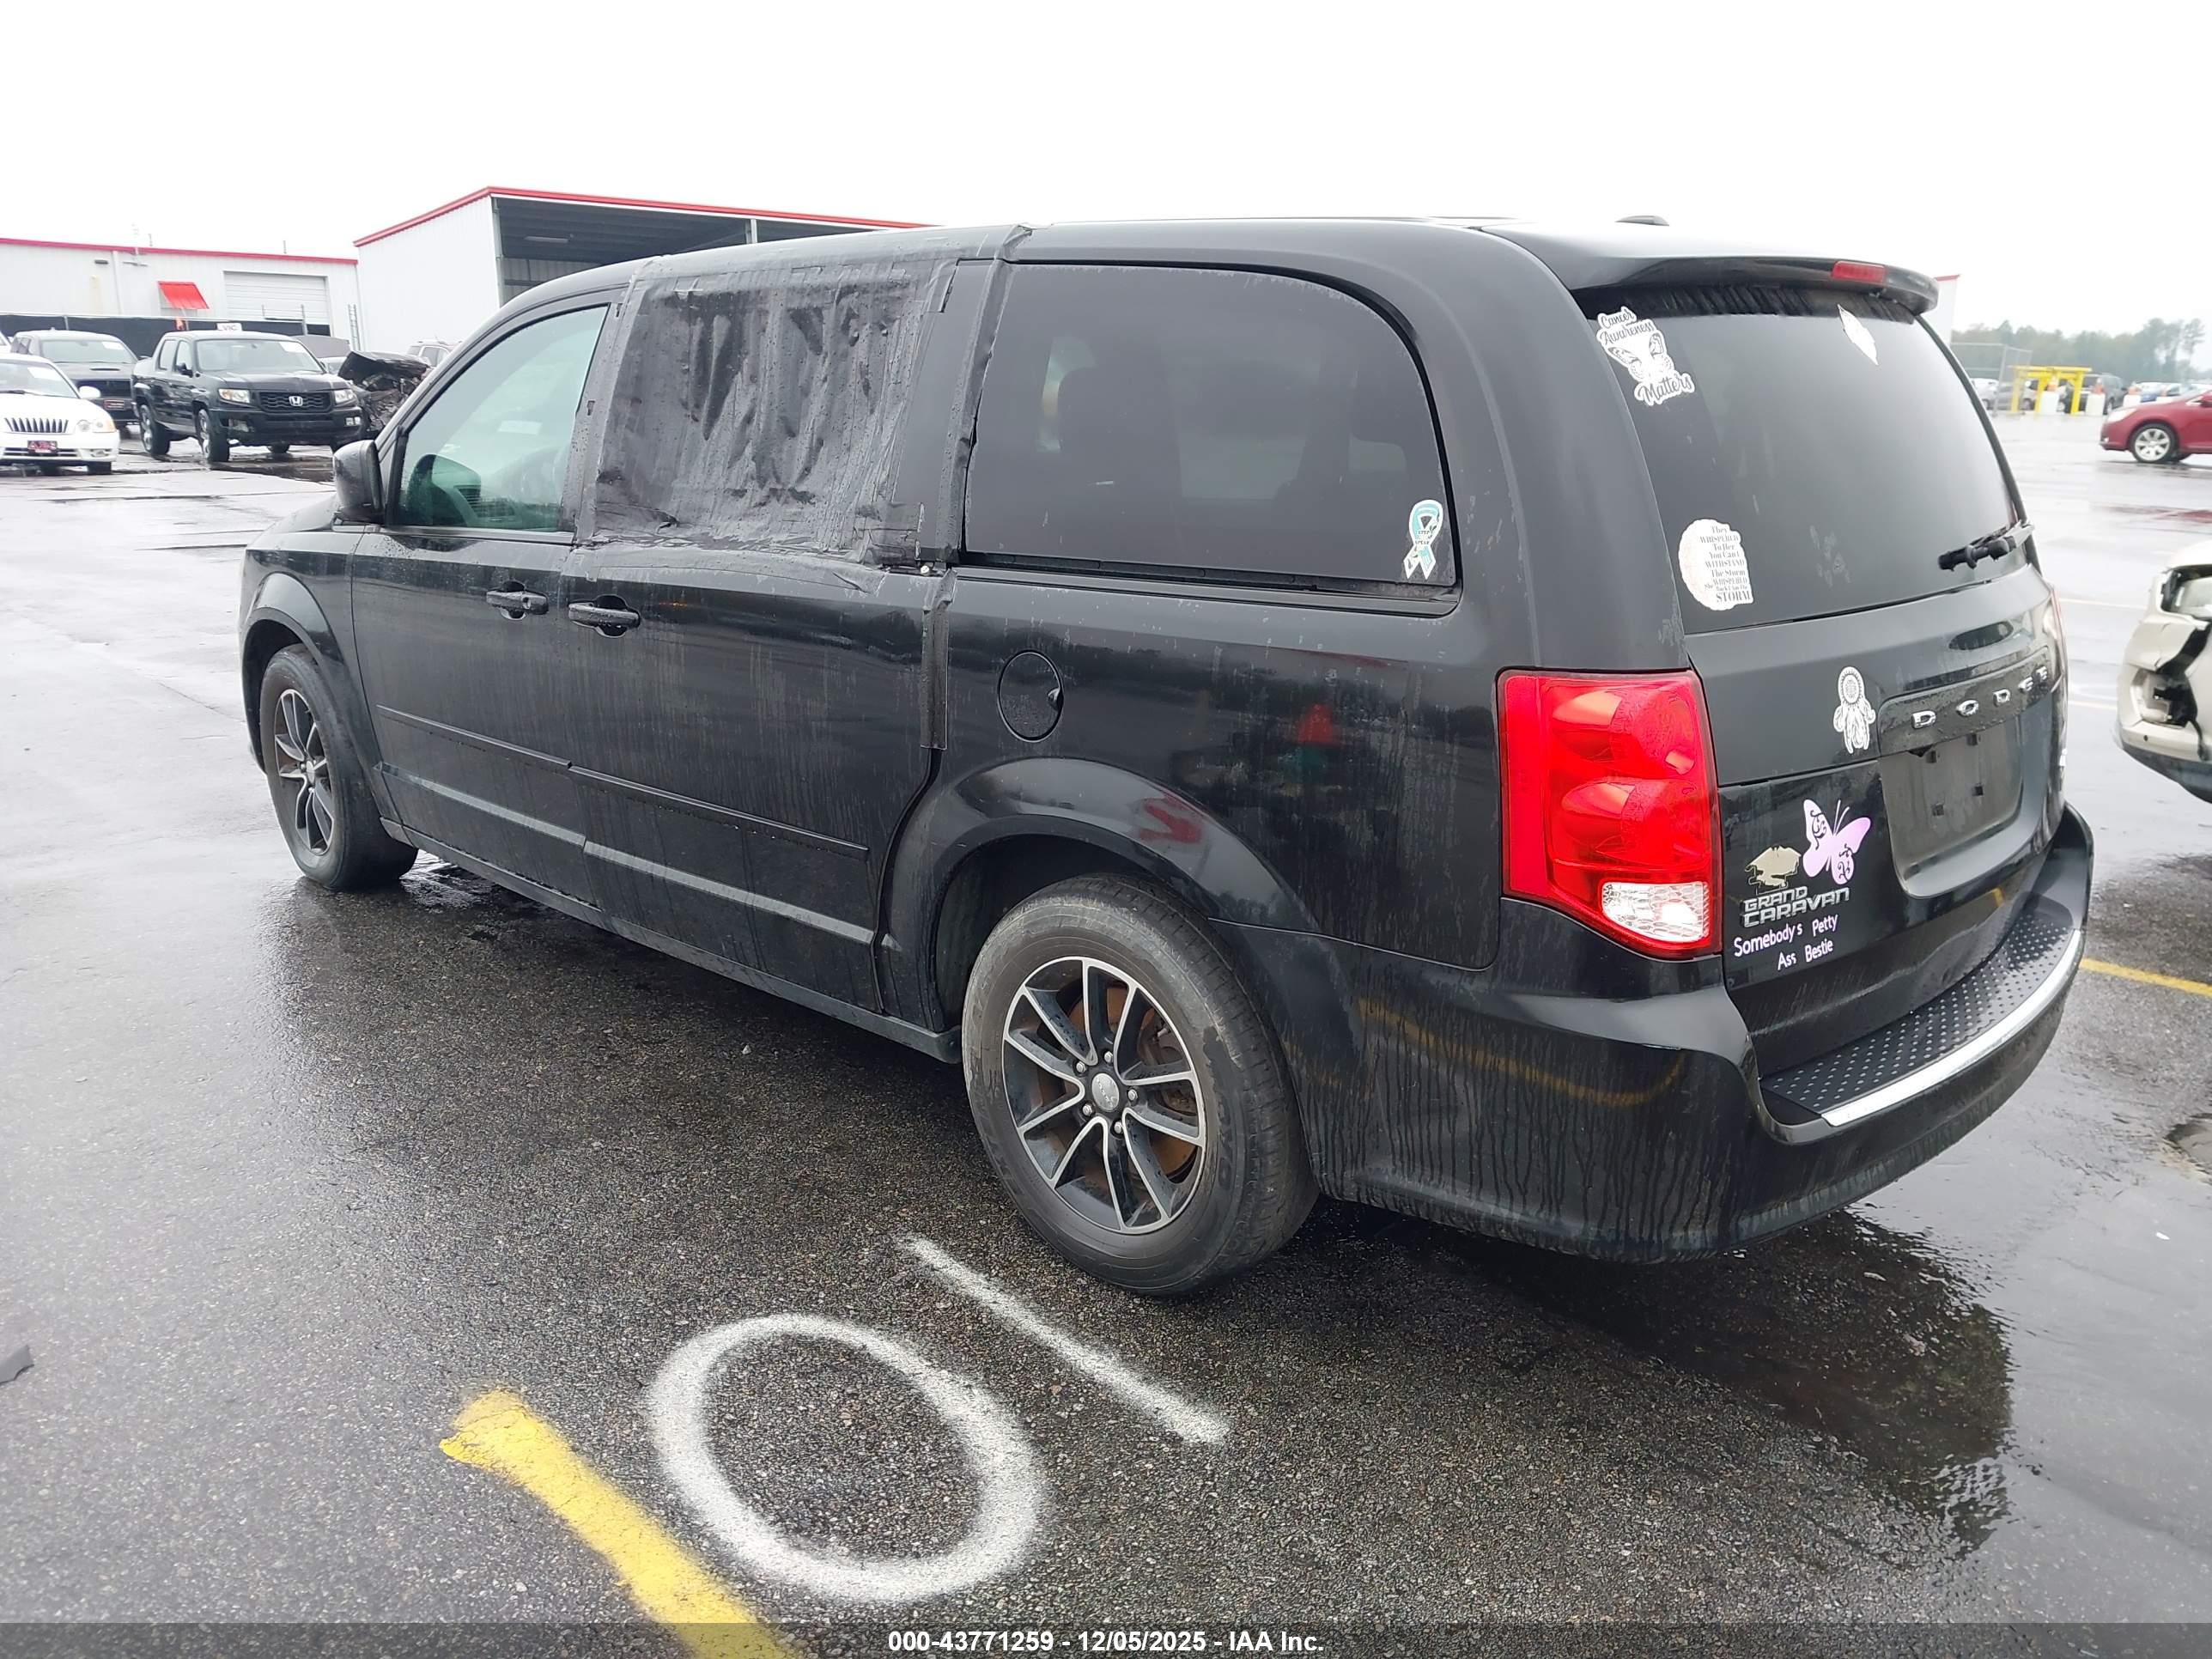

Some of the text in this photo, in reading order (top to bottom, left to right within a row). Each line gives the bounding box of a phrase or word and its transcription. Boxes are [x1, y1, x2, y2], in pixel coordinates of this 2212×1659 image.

[1601, 310, 1636, 328] Cancer
[1599, 320, 1655, 345] Awareness
[1638, 374, 1692, 403] Matters
[1716, 591, 1751, 602] STORM
[1742, 887, 1850, 928] CARAVAN
[1743, 886, 1808, 913] GRAND
[1812, 914, 1838, 937] Petty
[1777, 938, 1833, 970] Ass Bestie
